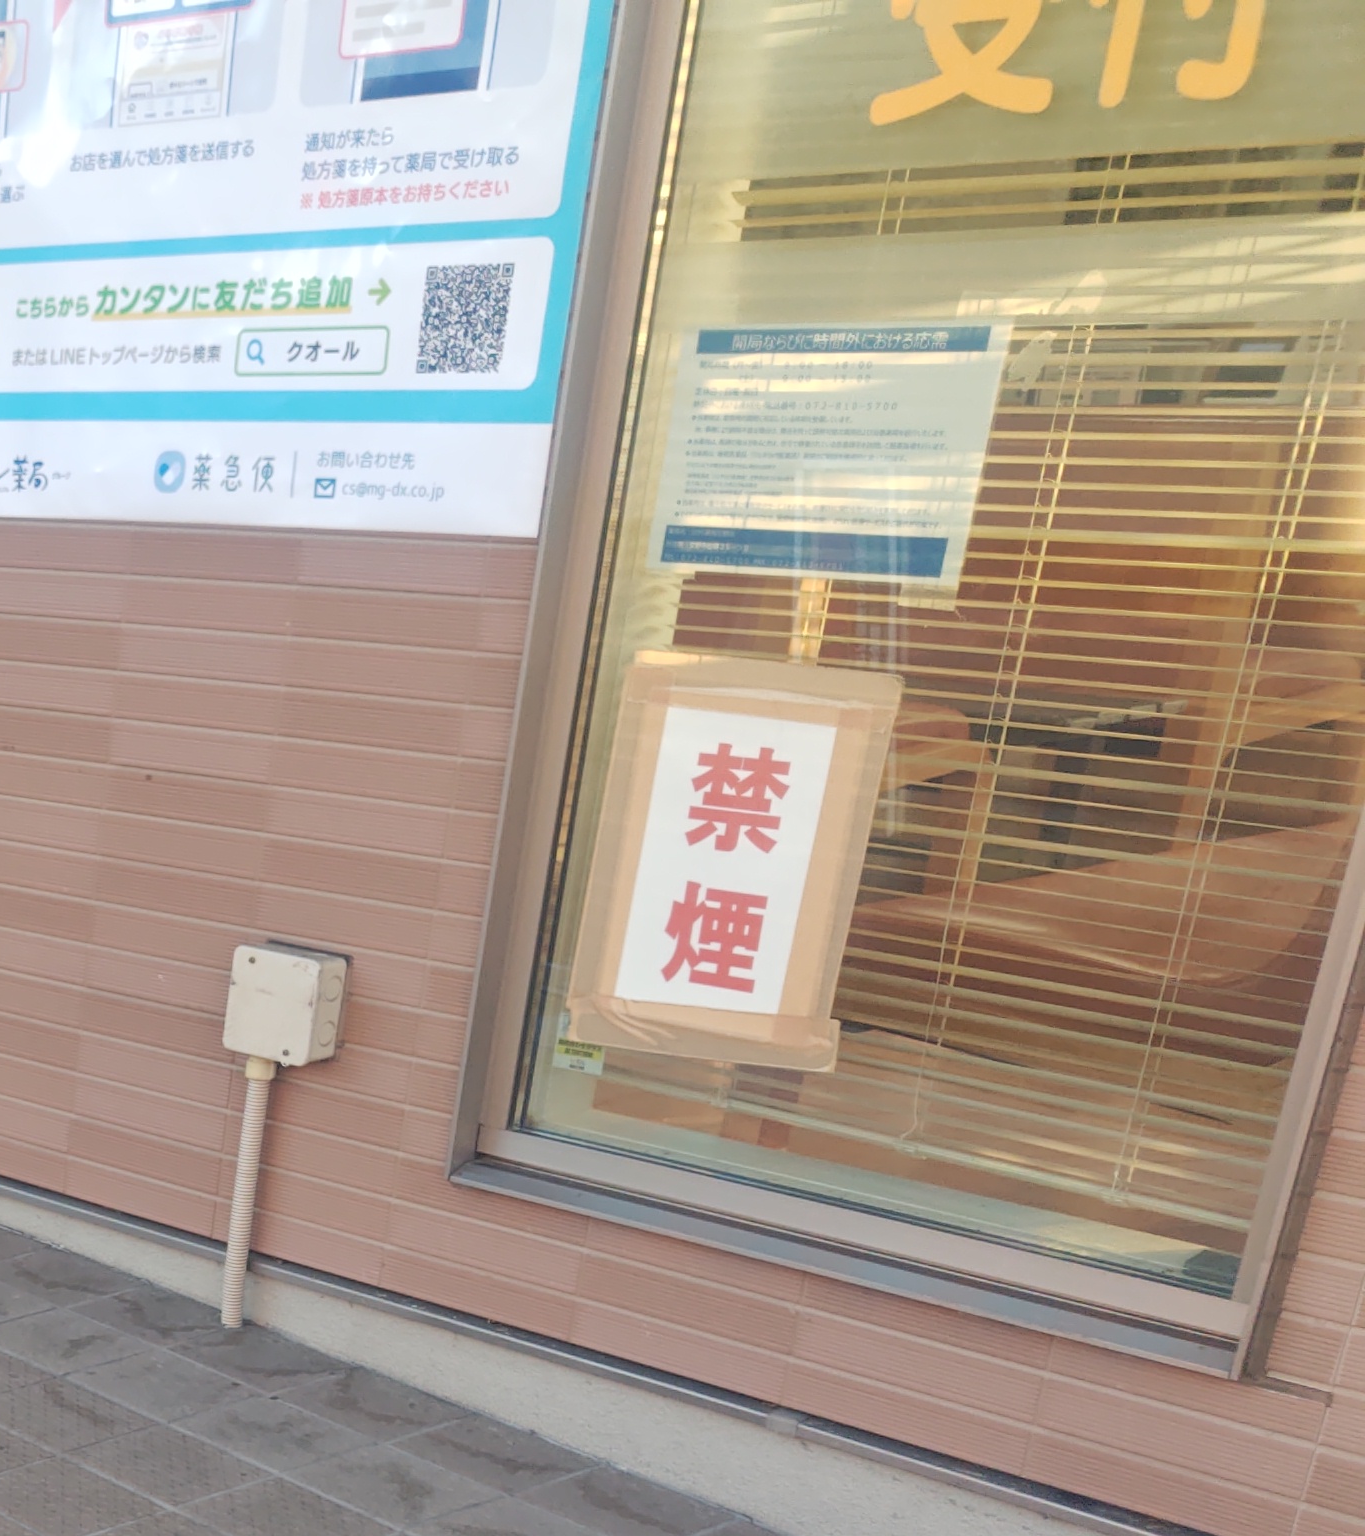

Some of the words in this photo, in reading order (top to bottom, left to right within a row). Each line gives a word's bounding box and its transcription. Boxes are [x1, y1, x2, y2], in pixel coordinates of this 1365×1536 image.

[304, 126, 395, 153] 通知が来たら
[69, 139, 255, 172] お店を選んで処方箋を送信する
[300, 146, 519, 182] 処方箋を持って薬局で受け取る
[287, 341, 360, 363] クオール
[732, 330, 950, 351] 開局ならびに時間外における応需
[191, 453, 276, 493] 薬急便
[316, 450, 416, 471] お問い合わせ先
[342, 481, 445, 502] cs@mg-dx.co.jp
[661, 741, 790, 995] 禁煙
